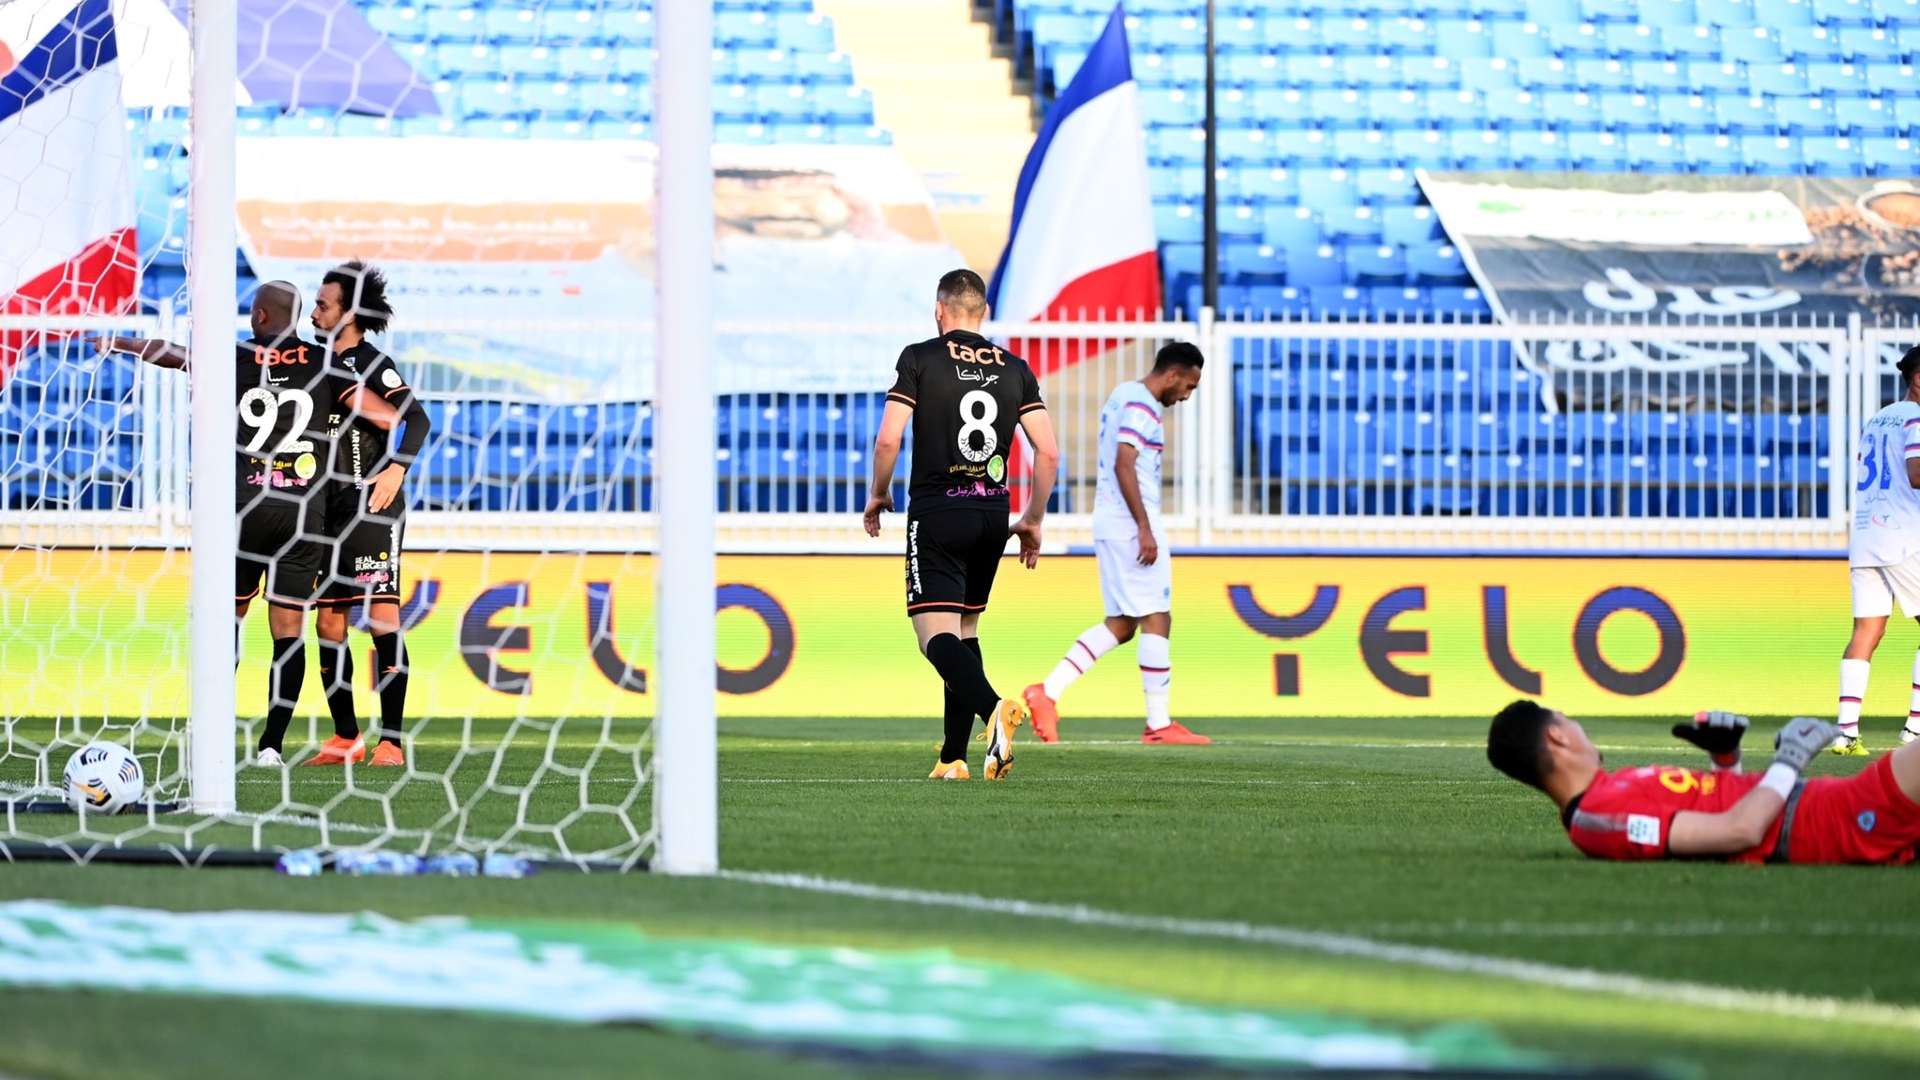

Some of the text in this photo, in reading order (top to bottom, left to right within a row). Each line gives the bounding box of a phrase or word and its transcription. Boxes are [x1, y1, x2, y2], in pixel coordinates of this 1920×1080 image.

[255, 345, 309, 366] tact
[946, 340, 1006, 367] tact
[955, 364, 1000, 388] جوانكا
[240, 387, 314, 453] 92
[957, 389, 998, 462] 8
[1226, 583, 1687, 698] YELO
